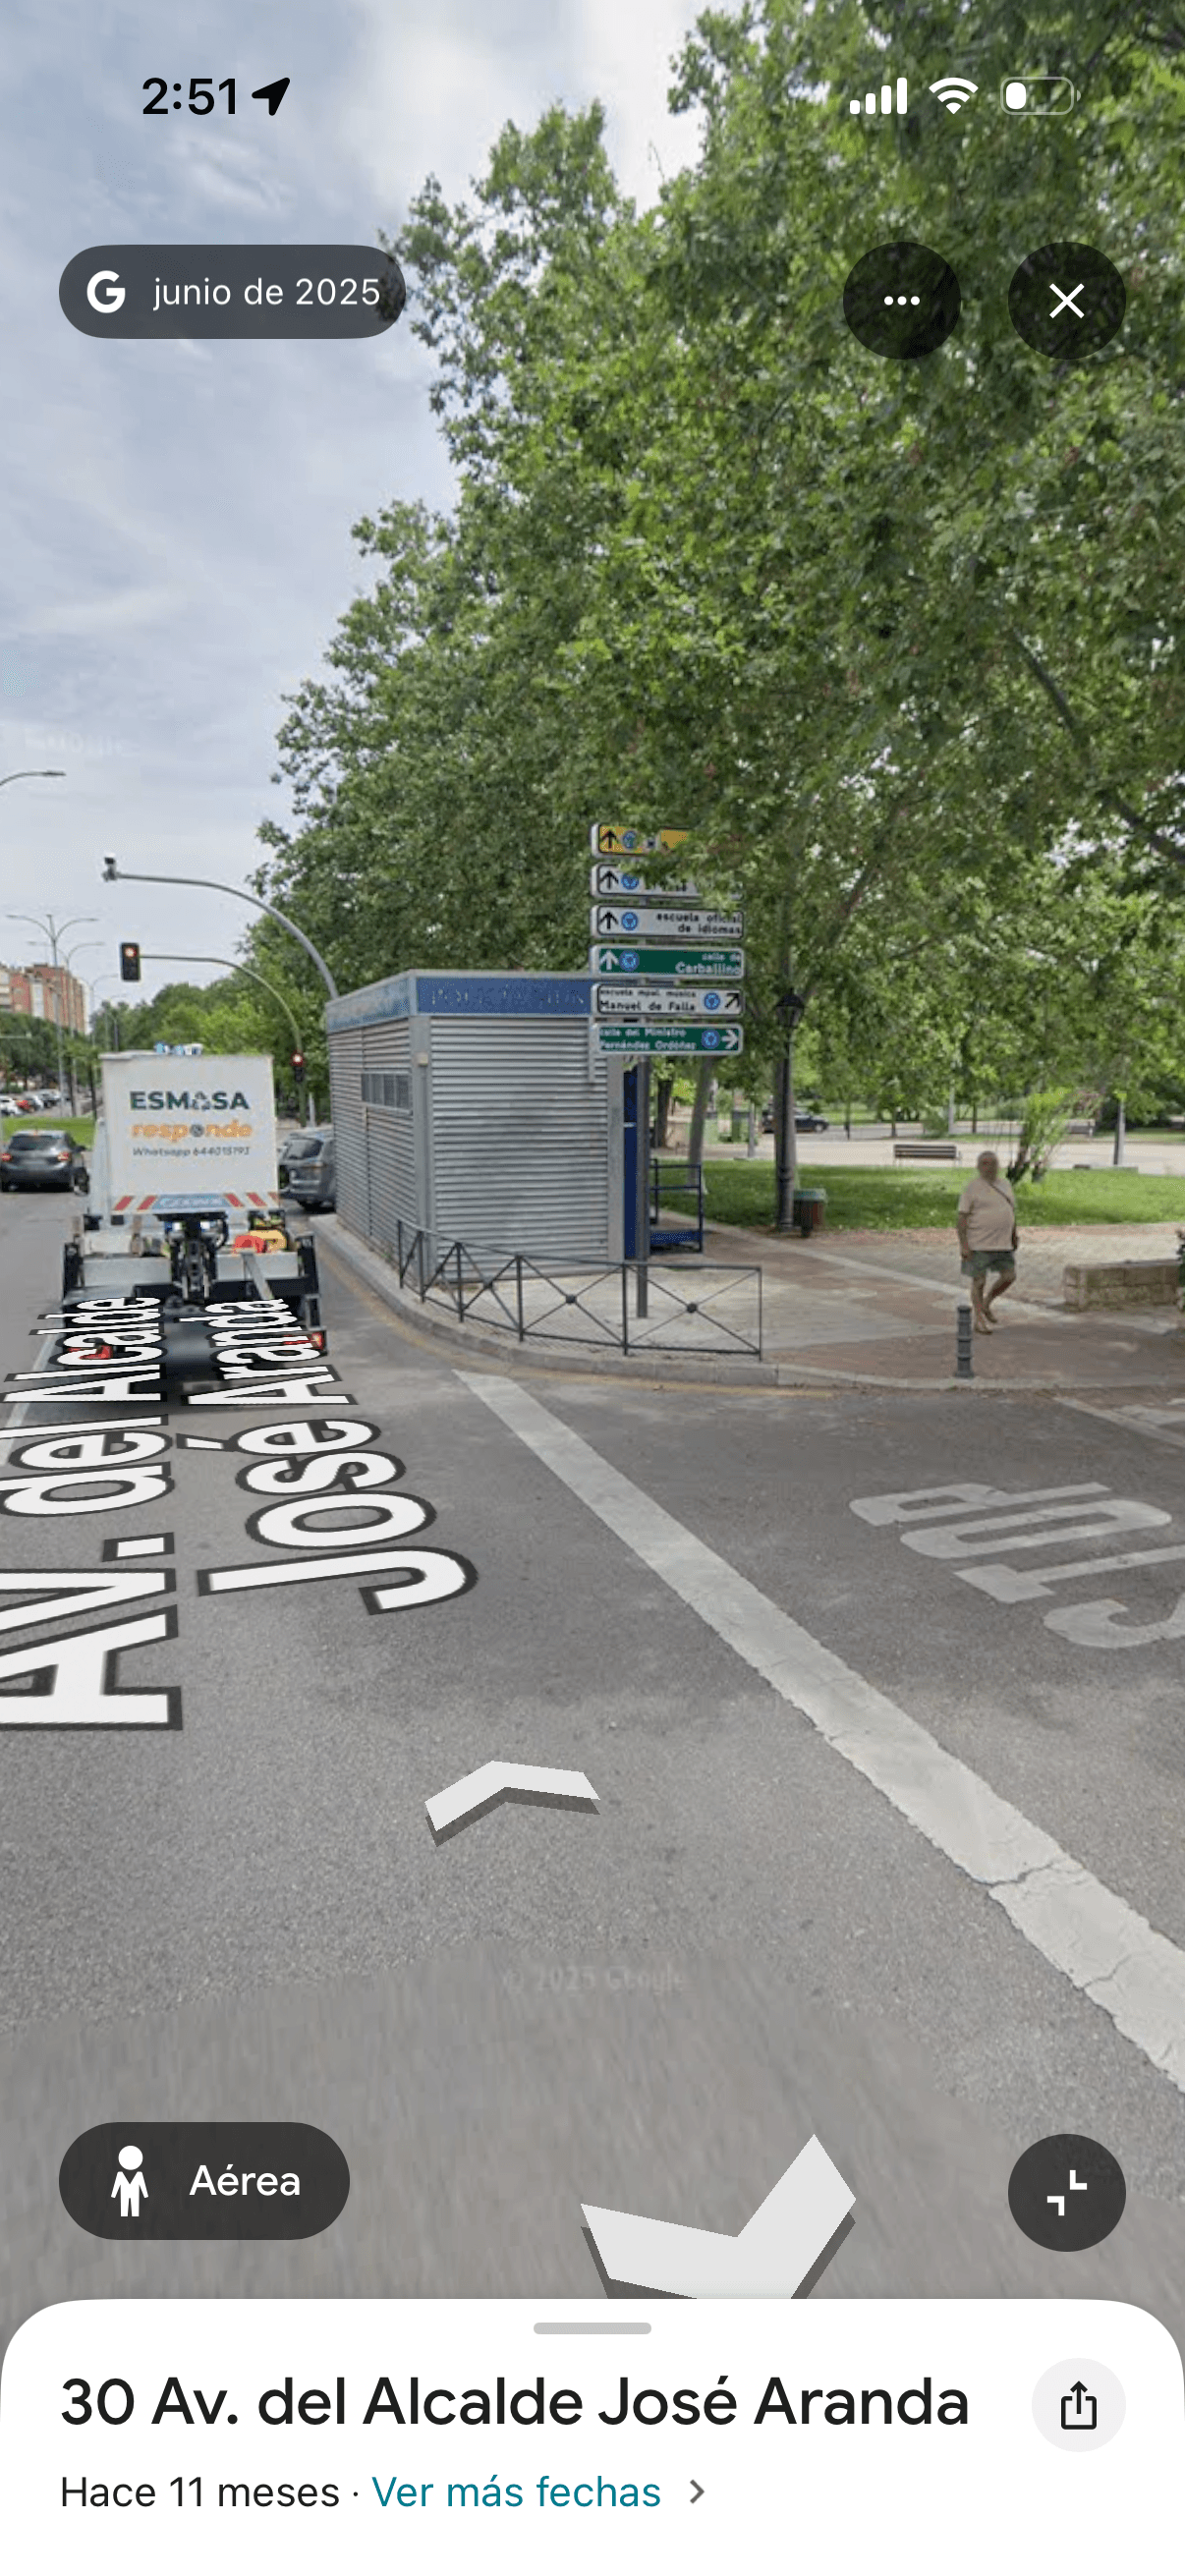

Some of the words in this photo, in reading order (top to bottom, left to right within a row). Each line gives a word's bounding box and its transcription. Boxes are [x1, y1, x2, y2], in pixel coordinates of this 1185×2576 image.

[656, 912, 700, 923] escuela
[678, 924, 691, 933] de
[698, 924, 742, 934] idiomas
[701, 952, 726, 961] calle
[729, 952, 742, 962] de
[600, 1000, 642, 1011] Manuel
[648, 1001, 662, 1011] de
[668, 1001, 696, 1011] Falla
[645, 1029, 687, 1037] Ministro
[130, 1091, 250, 1110] ESMASA
[132, 1120, 253, 1143] responde
[133, 1148, 191, 1156] Whatsapp
